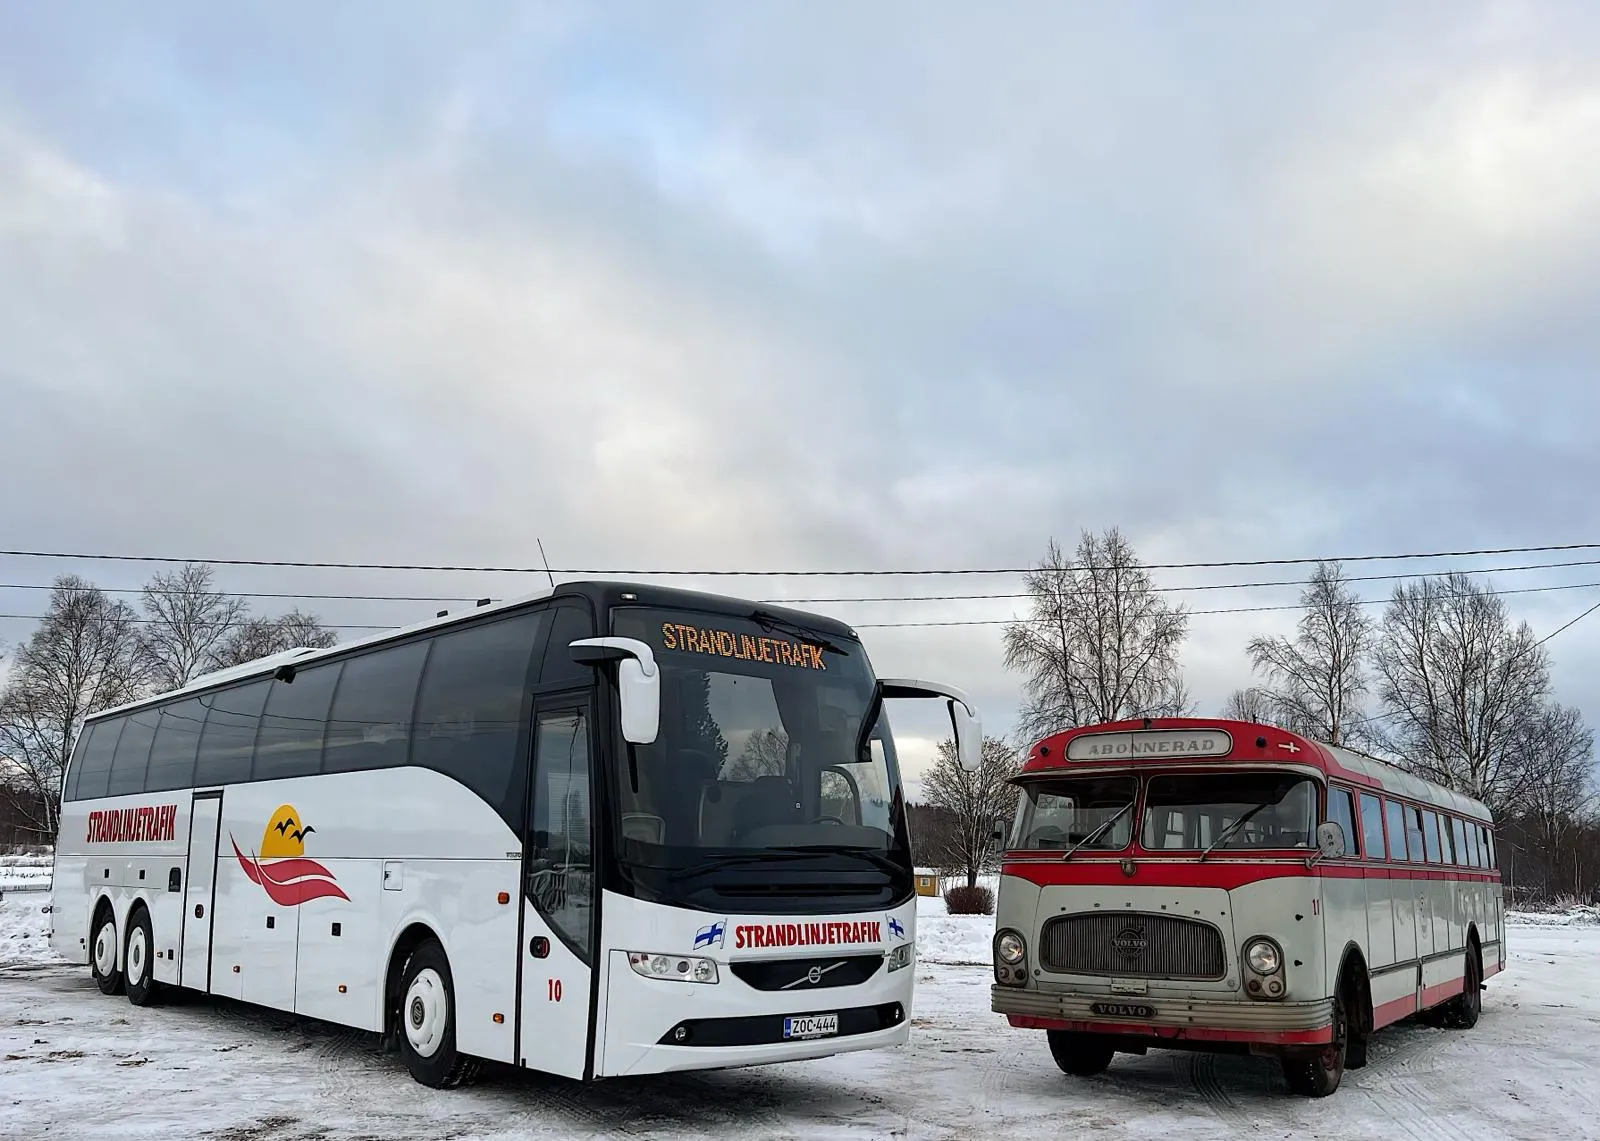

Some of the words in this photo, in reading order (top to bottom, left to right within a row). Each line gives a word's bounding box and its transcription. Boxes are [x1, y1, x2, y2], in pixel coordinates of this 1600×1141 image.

[662, 623, 826, 670] STRANDLINJETRAFIK
[1088, 739, 1215, 755] ABONNERAD
[87, 805, 177, 843] STRANDLINJETRAFIK
[1312, 899, 1320, 915] 11
[735, 921, 881, 949] STRANDLINJETRAFIK
[548, 979, 562, 1002] 10
[1098, 1004, 1147, 1016] VOLVO
[793, 1017, 835, 1034] ZOC-444
